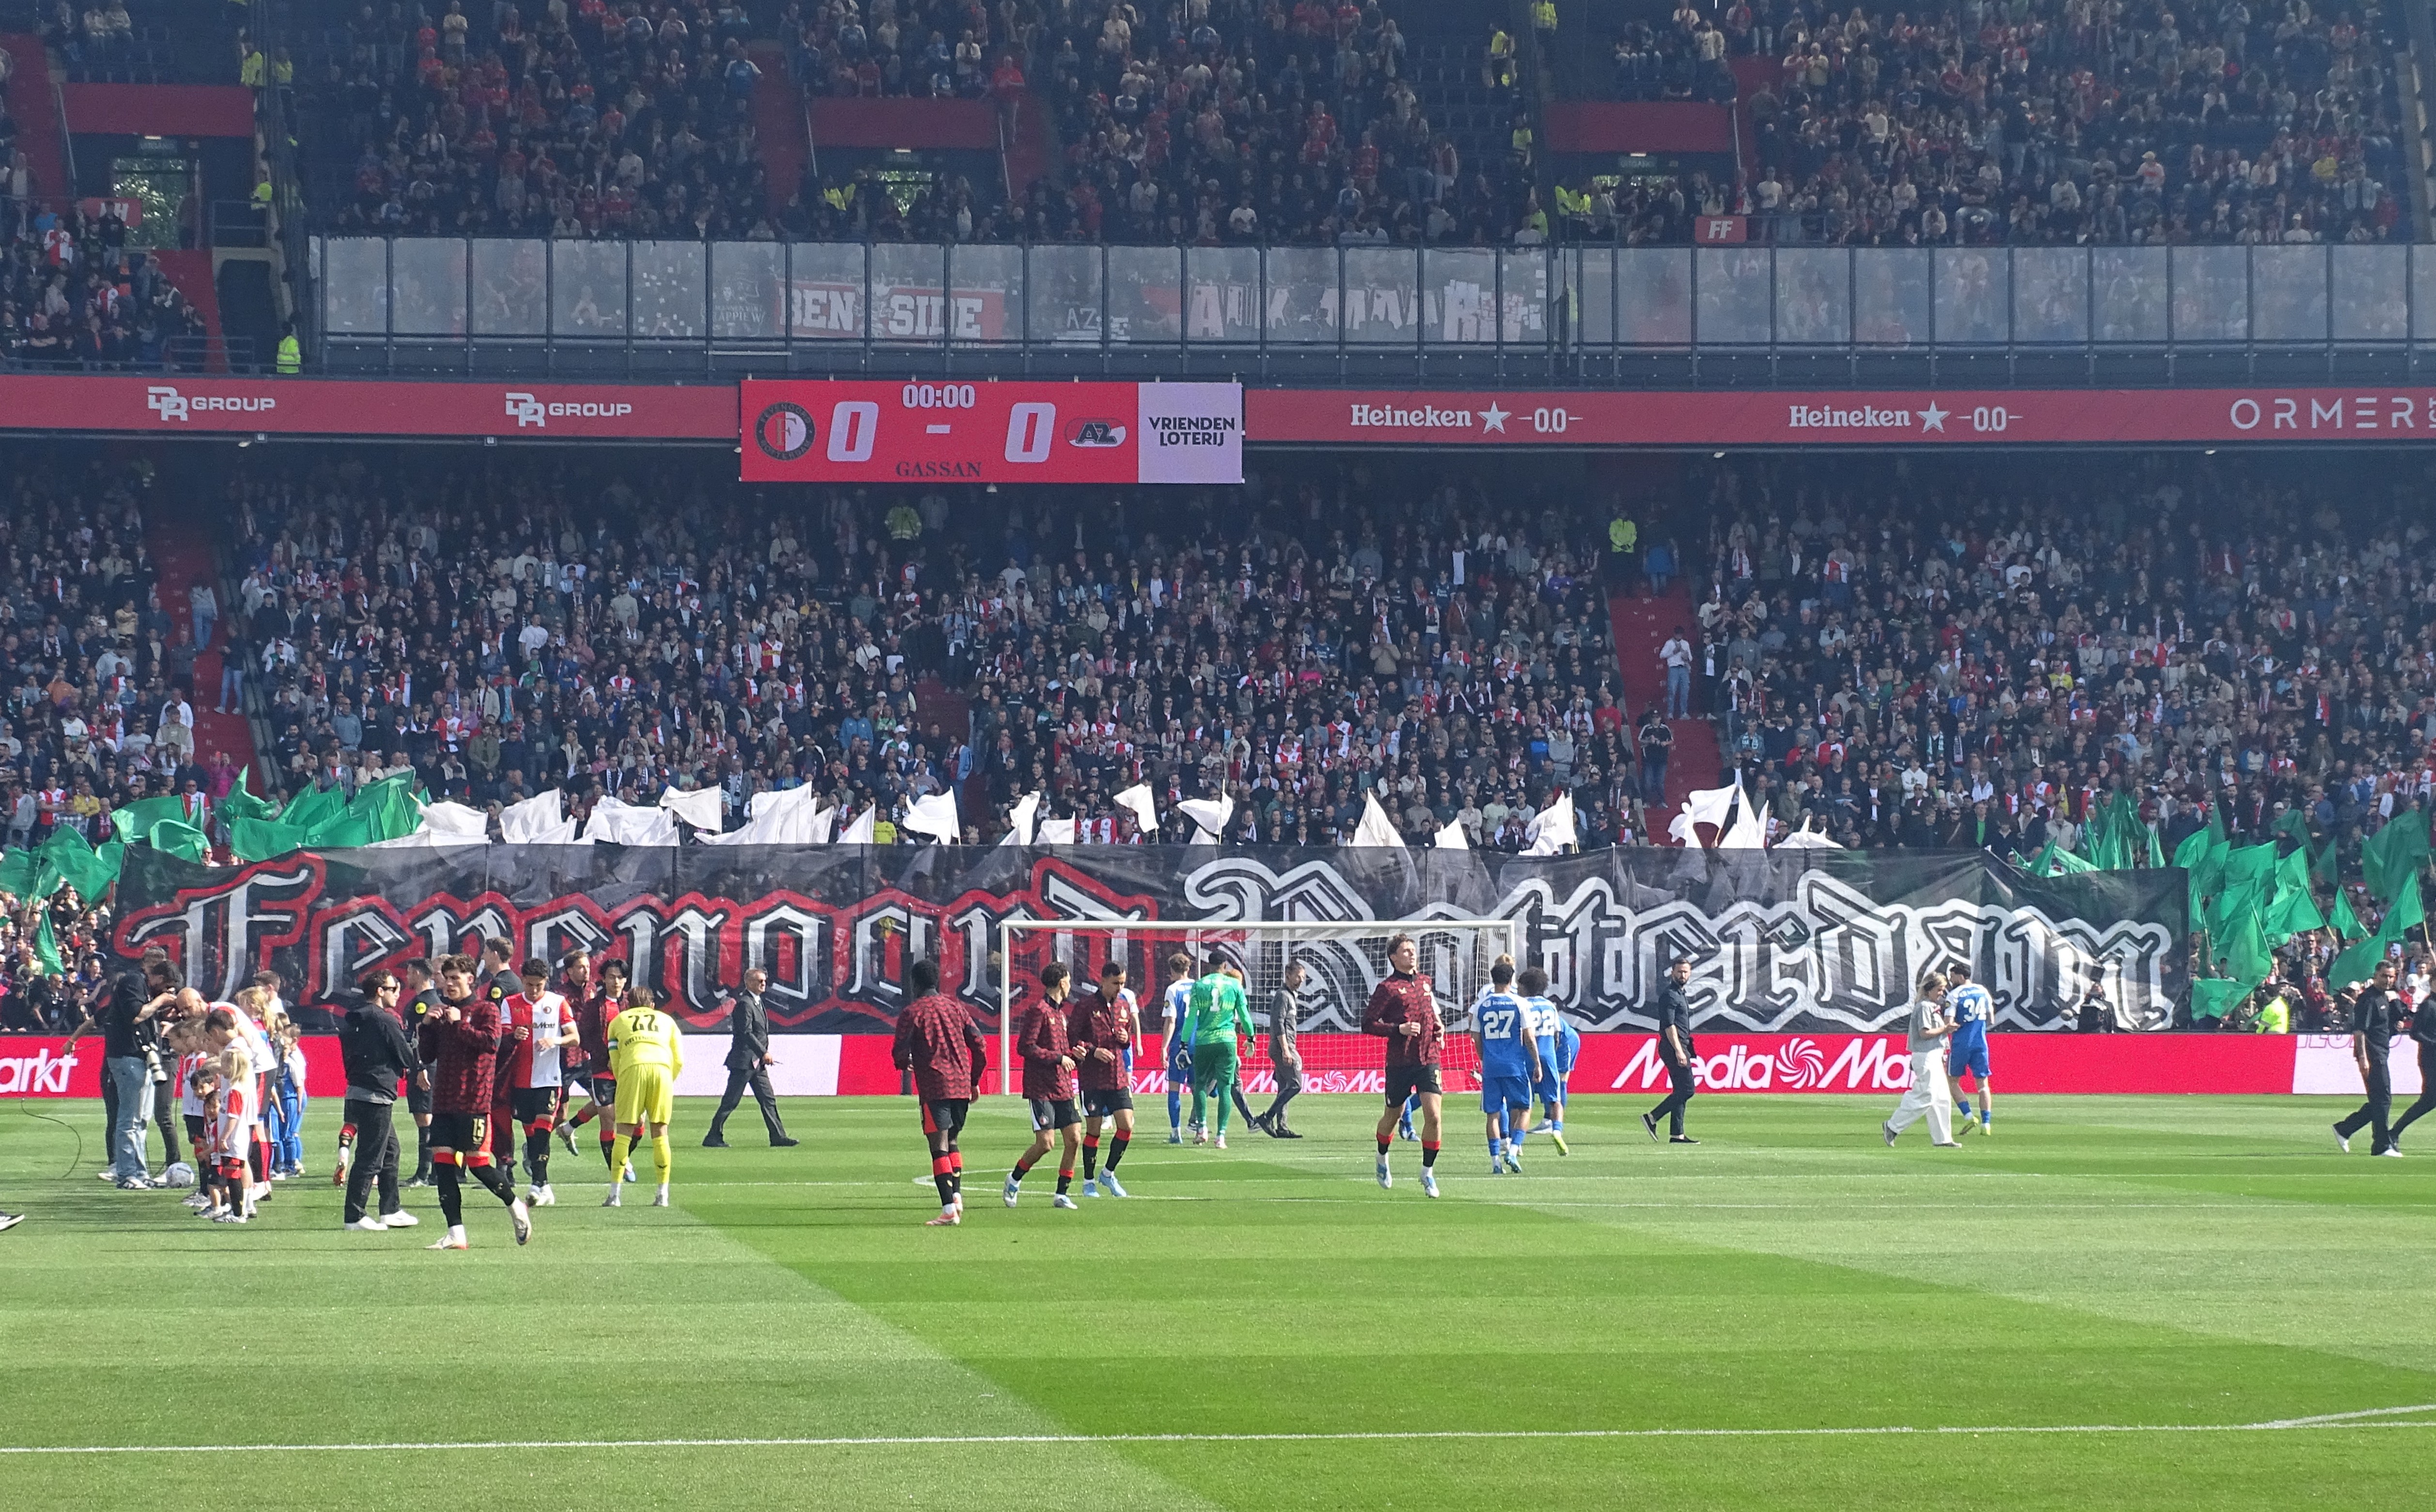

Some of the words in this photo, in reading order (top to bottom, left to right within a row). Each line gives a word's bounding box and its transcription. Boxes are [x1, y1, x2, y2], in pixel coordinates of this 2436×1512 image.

[99, 202, 128, 222] H
[1708, 220, 1733, 239] FF
[779, 287, 856, 331] BEN
[888, 294, 983, 338] SIDE
[1066, 307, 1097, 329] AZ
[147, 386, 188, 421] DR
[192, 397, 276, 411] GROUP
[903, 384, 975, 408] 00:00
[506, 393, 545, 427] DR
[549, 403, 632, 416] GROUP
[1351, 405, 1472, 427] Heineken
[1789, 405, 1911, 428] Heineken
[2230, 397, 2414, 429] ORMER
[827, 401, 879, 461] 0
[1004, 402, 1056, 462] 0
[1075, 423, 1117, 444] AZ
[1148, 417, 1235, 430] VRIENDEN
[1159, 432, 1224, 446] LOTERIJ
[895, 461, 982, 477] GASSAN
[1210, 987, 1220, 1012] 1
[1963, 997, 1987, 1022] 34
[628, 1014, 659, 1032] 22
[1483, 1010, 1515, 1039] 27
[1529, 1009, 1555, 1036] 22
[473, 1118, 485, 1137] 15
